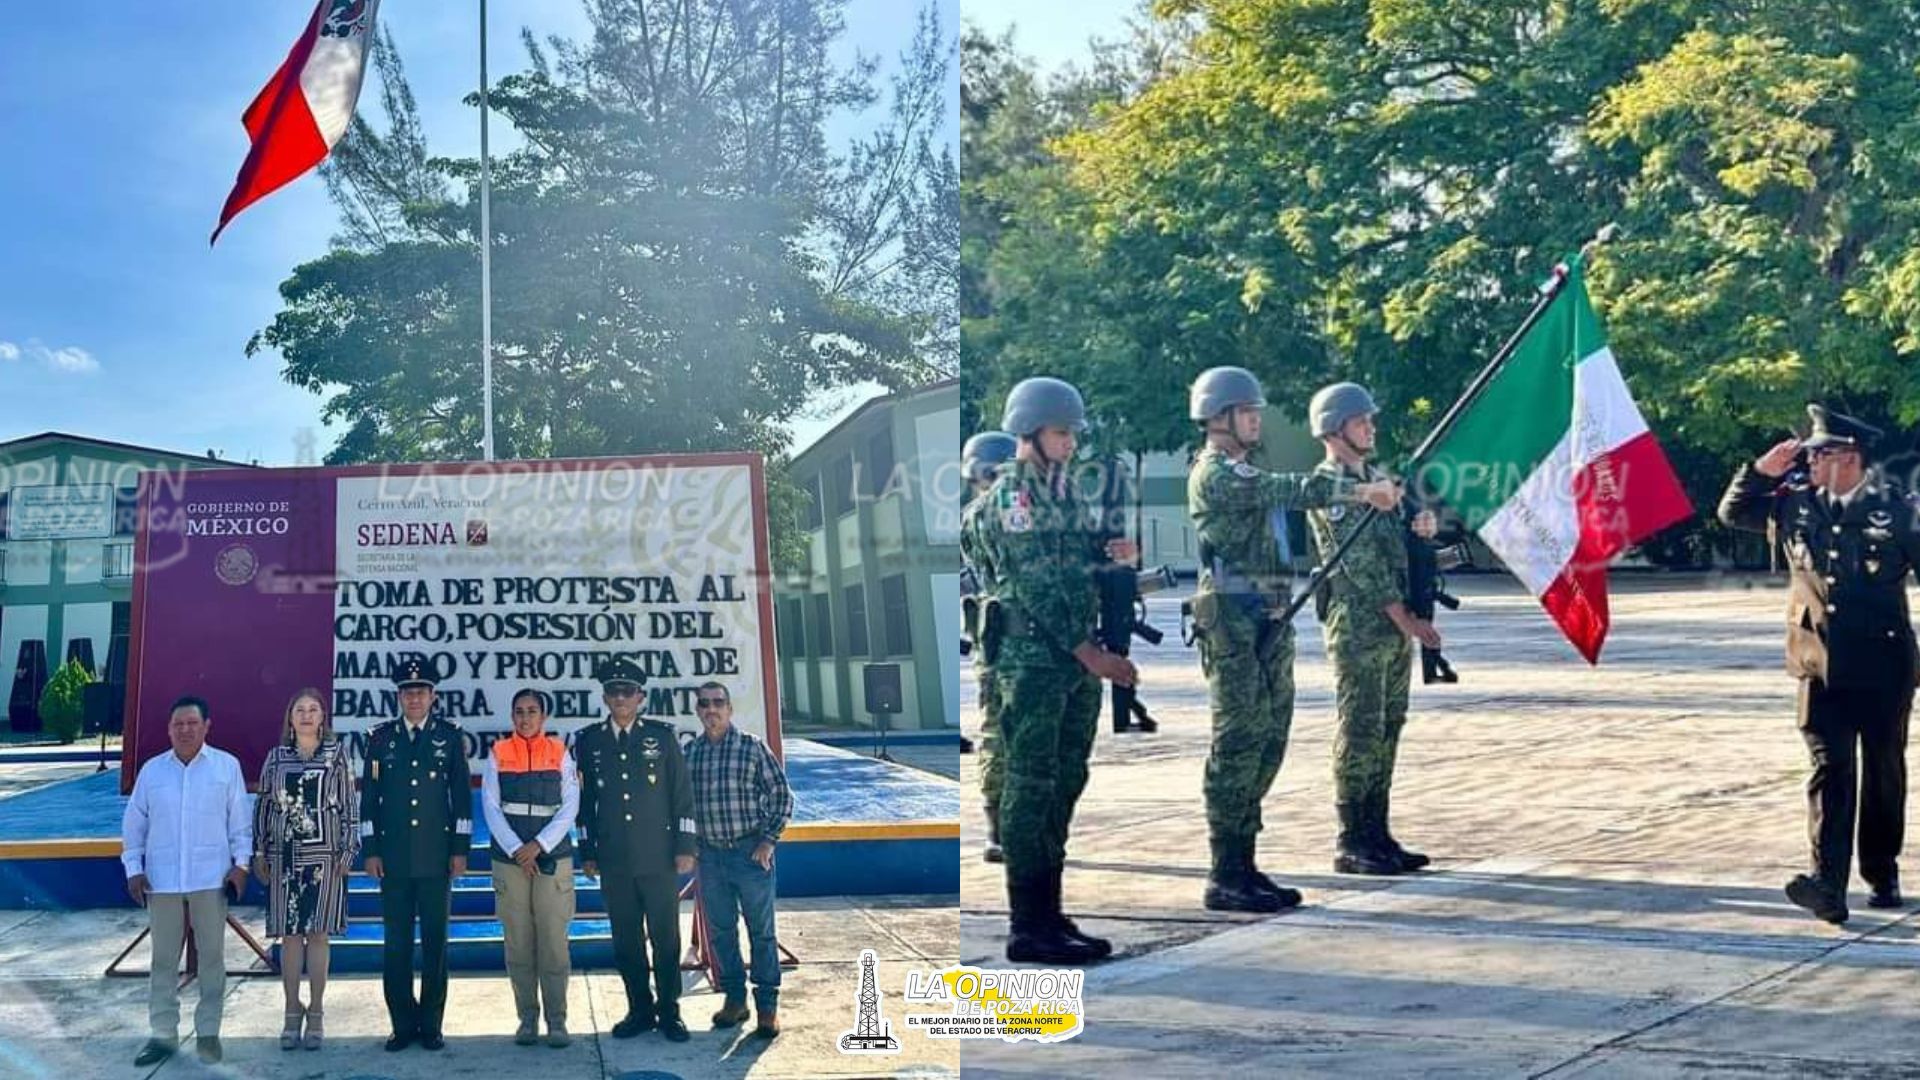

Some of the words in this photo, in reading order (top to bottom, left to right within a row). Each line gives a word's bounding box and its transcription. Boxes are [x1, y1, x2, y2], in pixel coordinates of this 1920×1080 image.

[187, 502, 265, 514] GOBIERNO
[268, 501, 289, 513] DE
[186, 514, 289, 536] MÉXICO
[357, 522, 458, 547] SEDENA
[336, 579, 433, 609] TOMA
[441, 577, 484, 607] DE
[492, 574, 677, 605] PROTESTA
[697, 574, 745, 602] AL
[648, 610, 724, 640] DEL
[463, 651, 487, 680] Y
[691, 647, 739, 676] DE
[330, 688, 494, 718] BANERA
